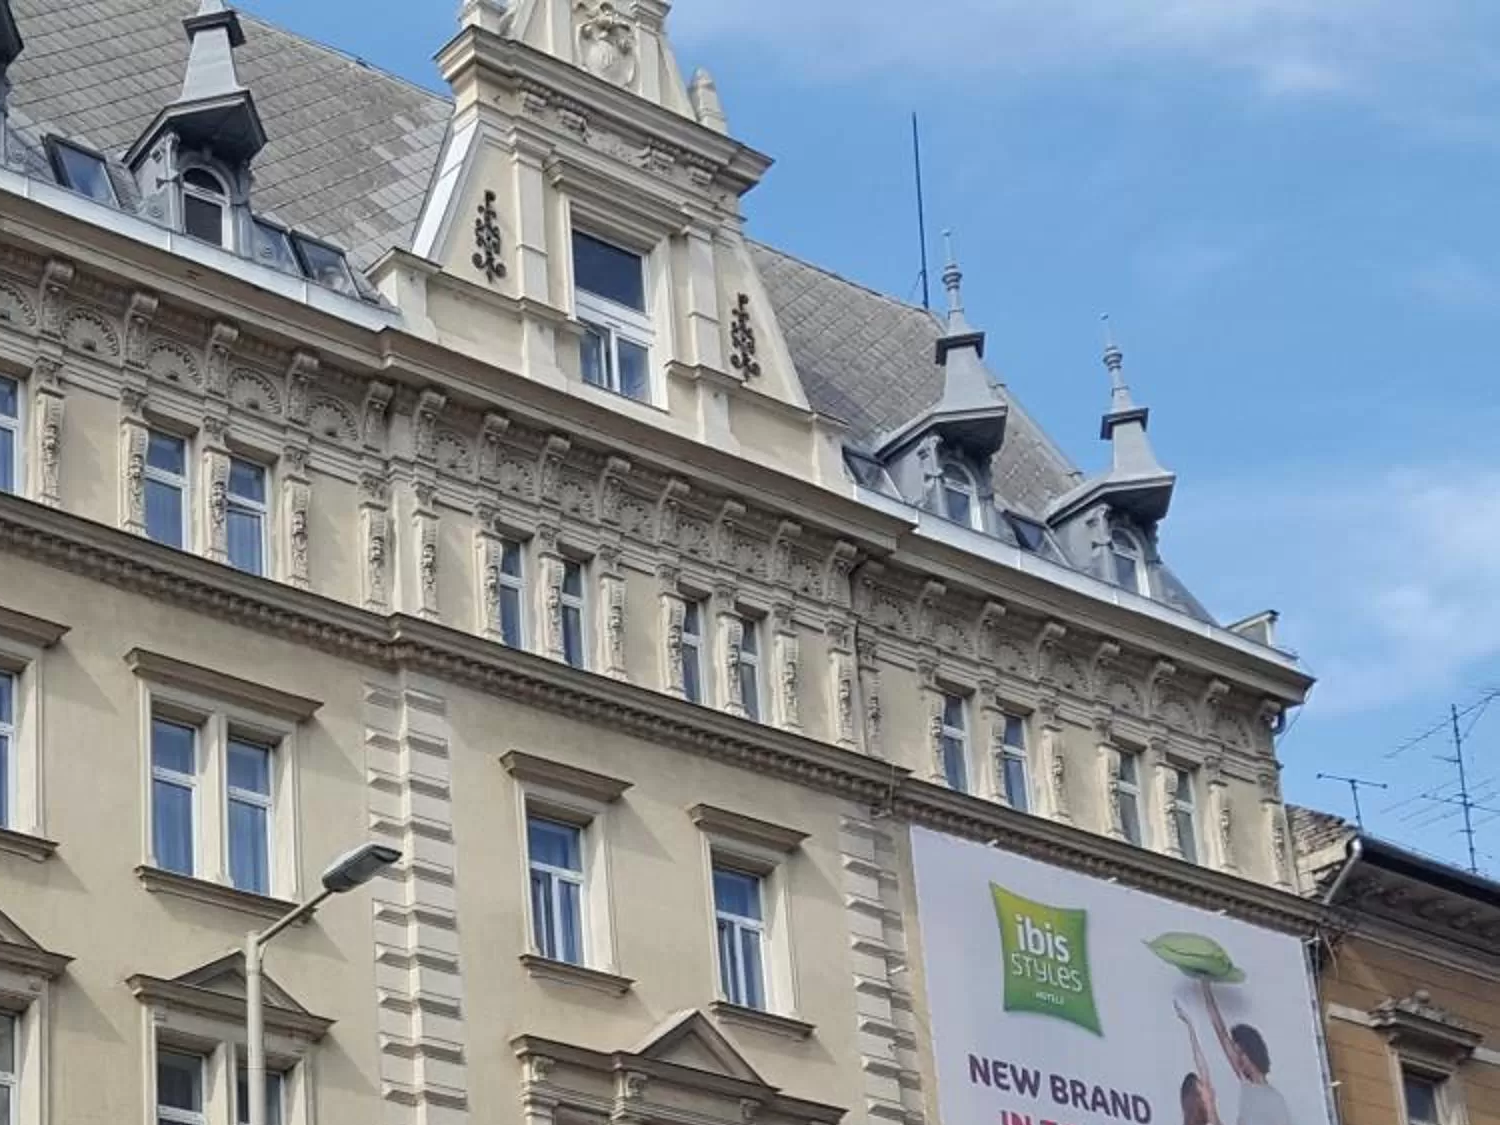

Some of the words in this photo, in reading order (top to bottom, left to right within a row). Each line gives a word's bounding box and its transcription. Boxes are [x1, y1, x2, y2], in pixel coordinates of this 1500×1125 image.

[1015, 913, 1070, 963] ibis
[968, 1053, 1041, 1098] NEW
[1050, 1074, 1152, 1125] BRAND
